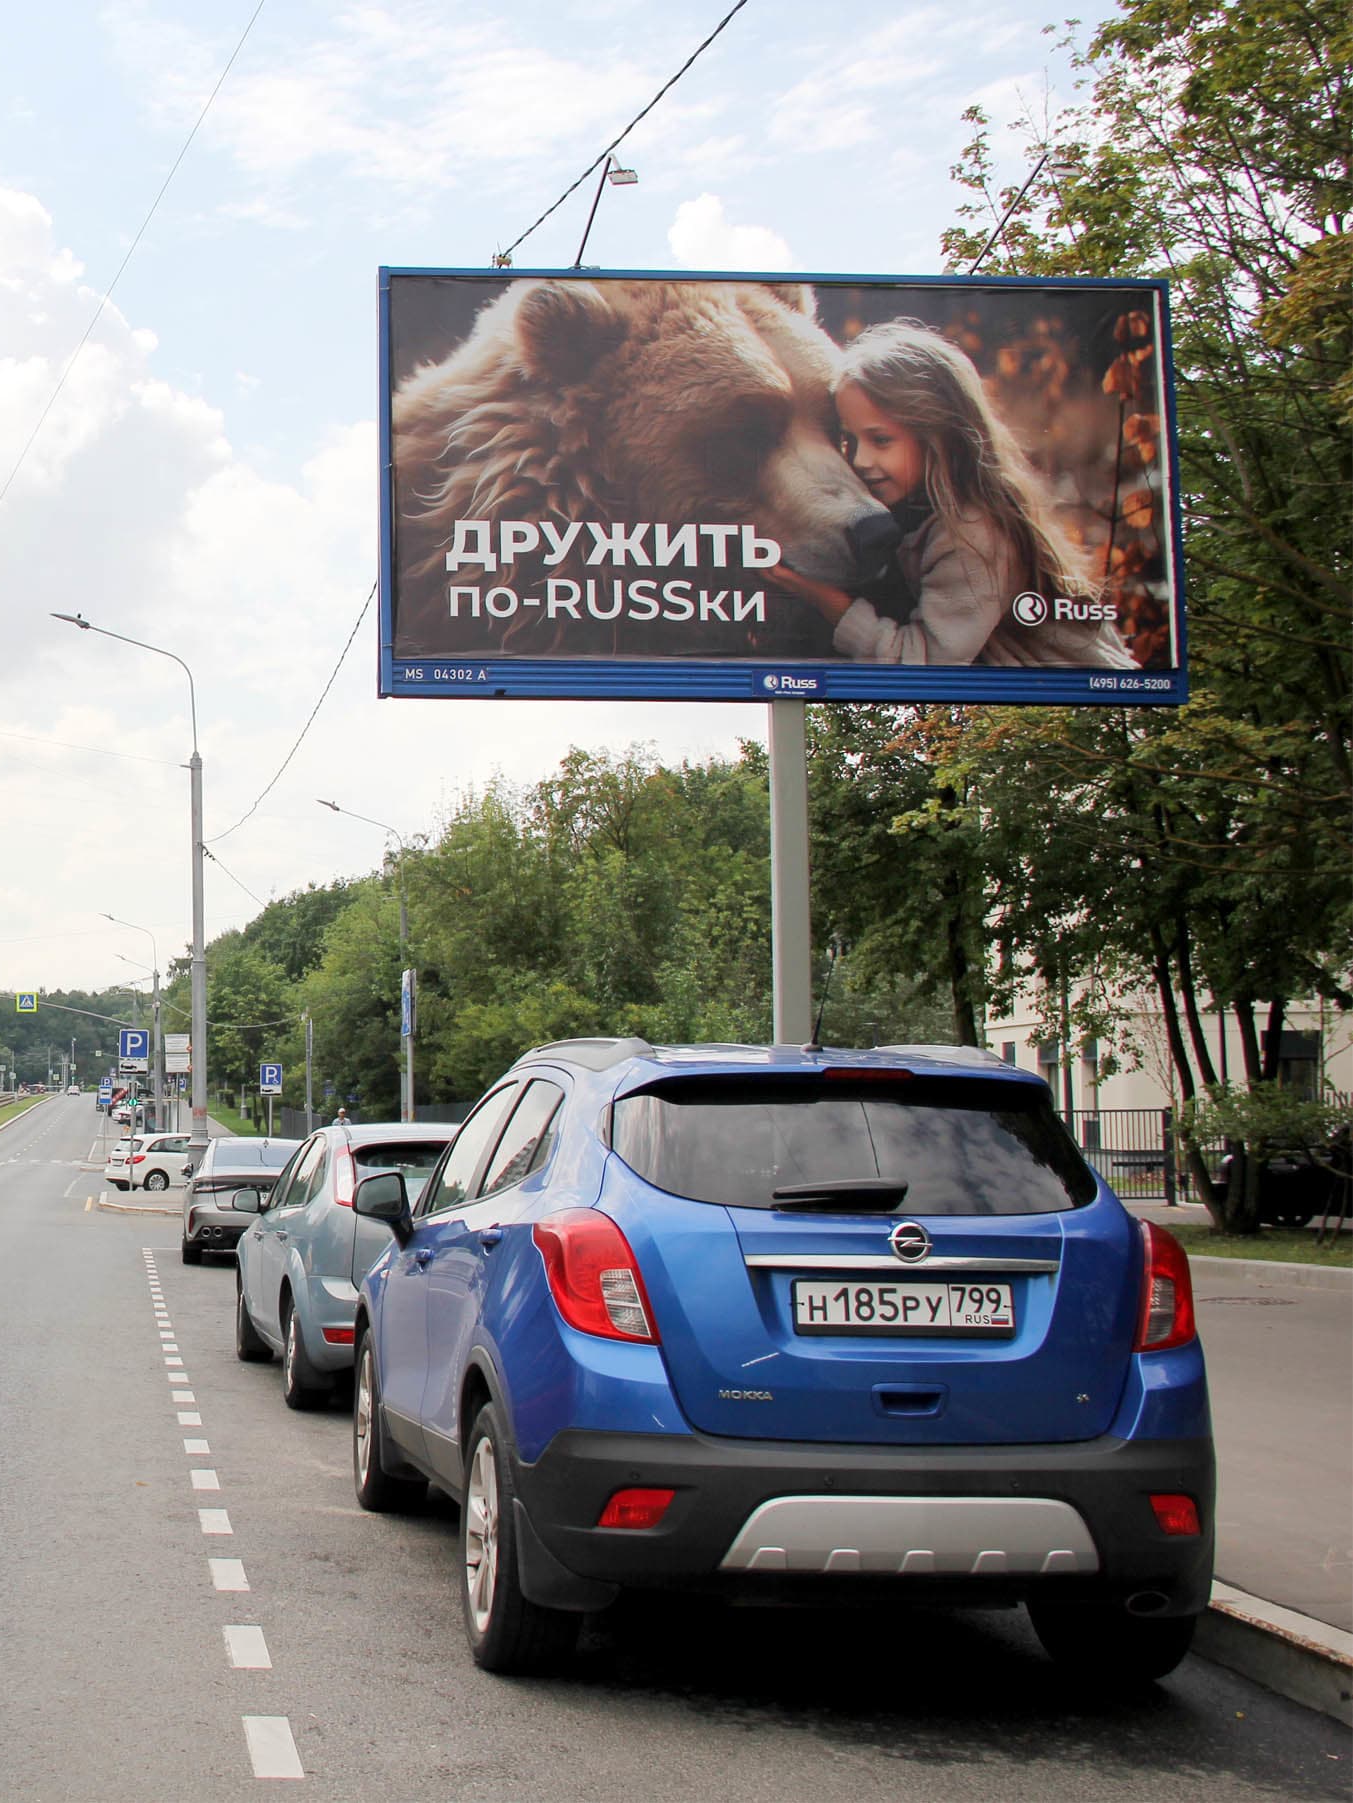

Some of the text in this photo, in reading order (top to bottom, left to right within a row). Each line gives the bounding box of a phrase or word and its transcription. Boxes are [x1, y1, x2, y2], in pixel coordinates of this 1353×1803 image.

[445, 519, 782, 572] ДРУЖИТЬ
[1054, 598, 1118, 620] Russ
[405, 668, 486, 680] MS 04302 A
[781, 675, 817, 689] Russ
[1089, 677, 1171, 690] (495) 626-5200
[126, 1033, 143, 1056] P
[951, 1286, 1001, 1313] 799
[965, 1314, 990, 1325] RUS
[719, 1390, 774, 1401] MOKKA
